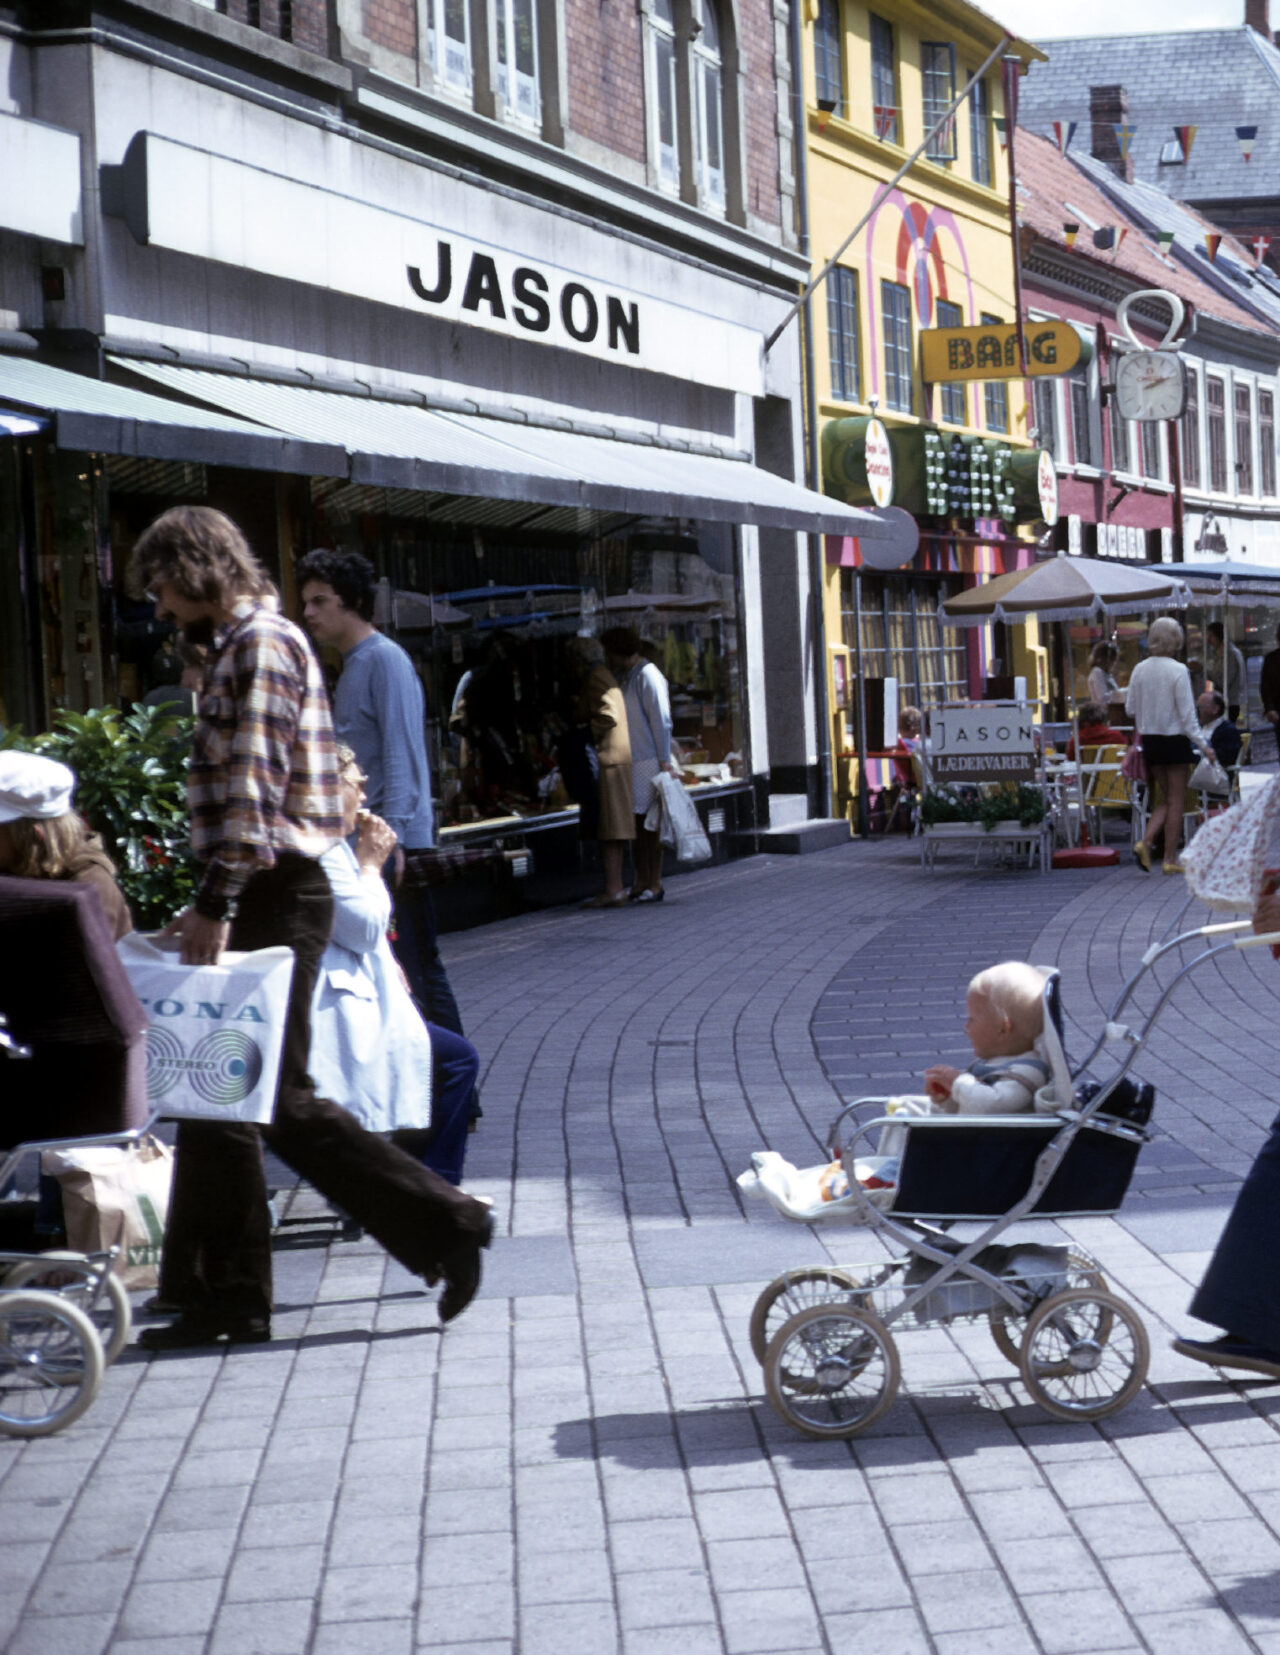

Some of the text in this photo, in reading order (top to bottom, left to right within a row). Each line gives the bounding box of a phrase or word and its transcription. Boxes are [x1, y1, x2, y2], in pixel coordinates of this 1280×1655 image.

[406, 240, 640, 354] JASON
[948, 331, 1057, 370] BANG
[935, 722, 1032, 750] JASON
[936, 755, 1031, 772] LÆDERVARER
[140, 998, 268, 1024] ONA
[156, 1058, 217, 1071] STEREO
